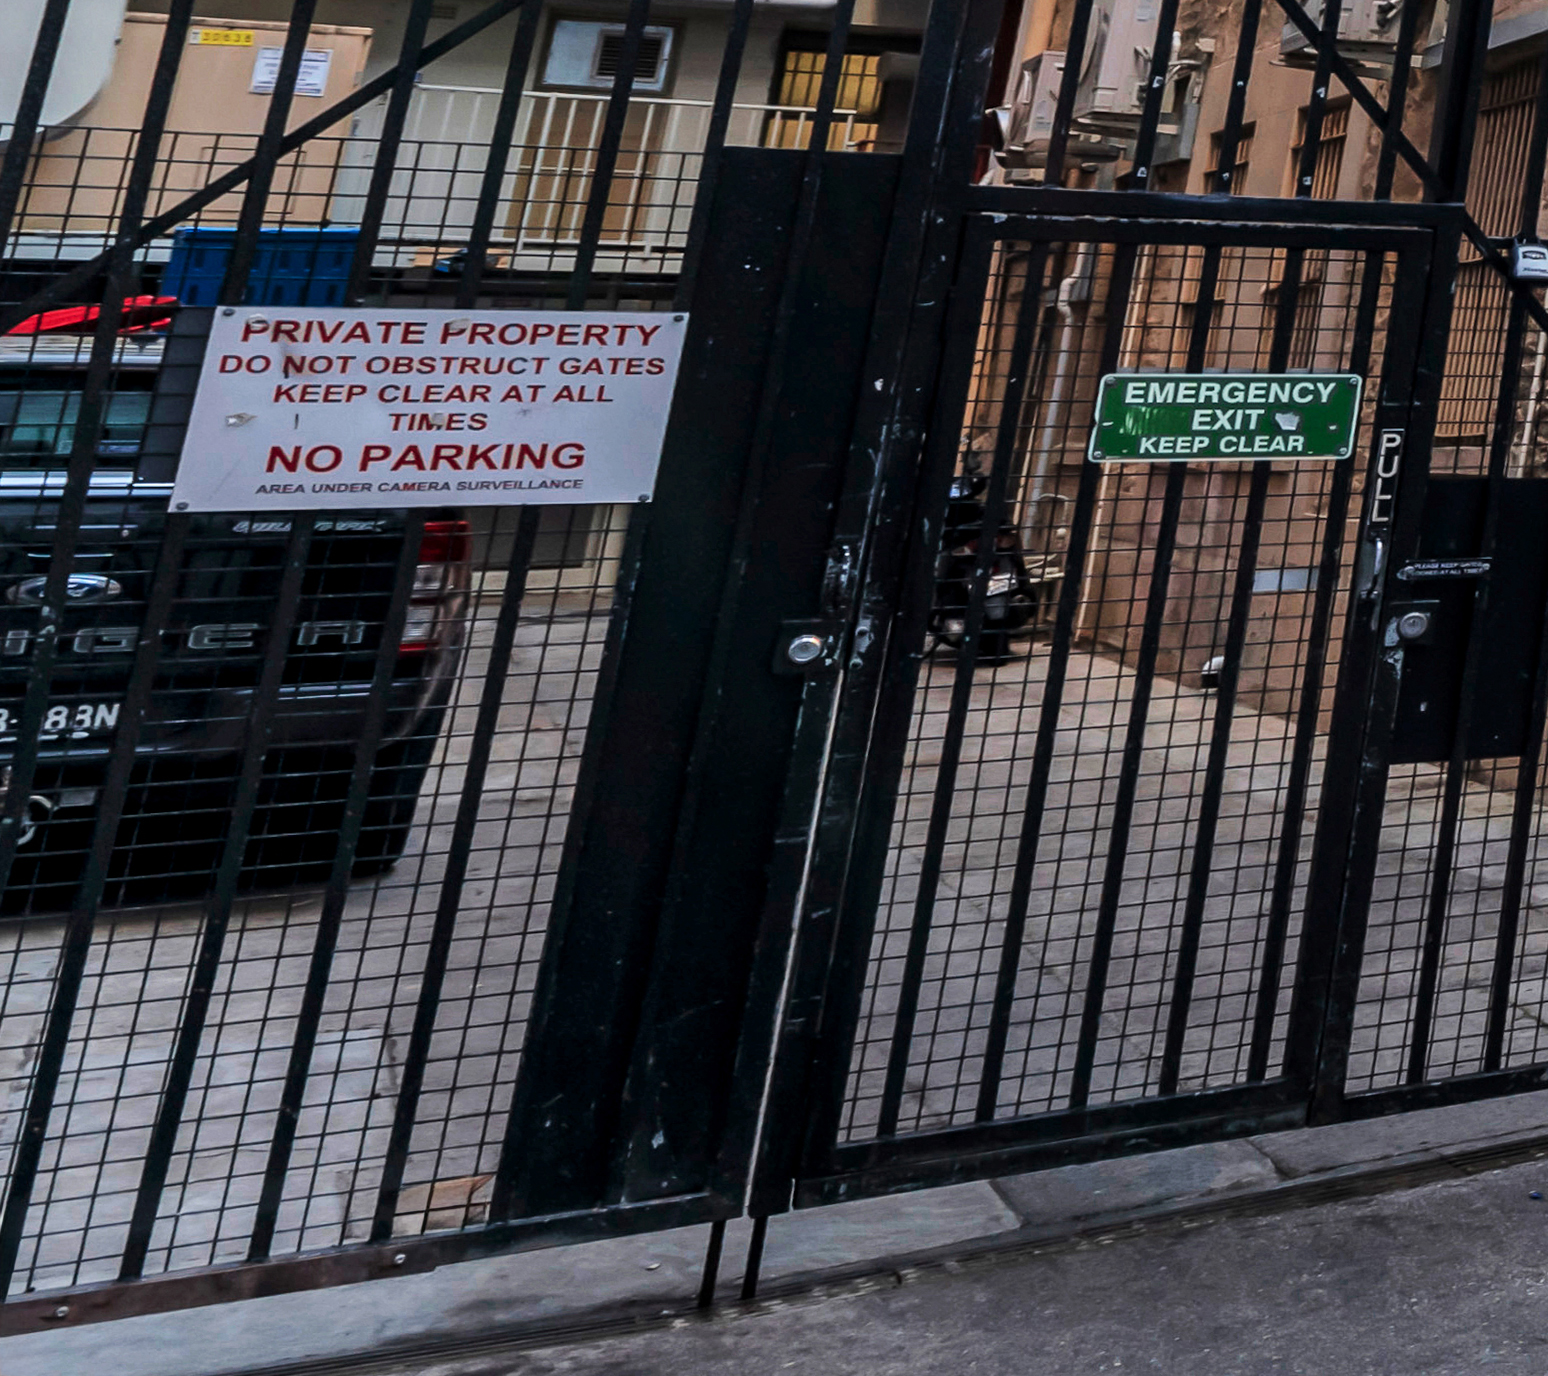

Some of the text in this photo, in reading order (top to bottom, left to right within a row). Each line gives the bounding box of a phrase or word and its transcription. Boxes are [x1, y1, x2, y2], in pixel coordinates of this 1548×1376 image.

[240, 319, 662, 347] PRIVATE PROPERTY
[218, 354, 666, 376] DO NOT OBSTRUCT GATES
[273, 383, 614, 403] KEEP CLEAR AT ALL
[1124, 382, 1336, 404] EMERGENCY
[388, 412, 489, 432] TIMES
[1191, 409, 1265, 431] EXIT
[1139, 435, 1305, 454] KEEP CLEAR
[265, 442, 585, 474] NO PARKING
[255, 479, 584, 495] AREA UNDER CAMERA SURVEILLANCE
[1372, 434, 1401, 522] PULL
